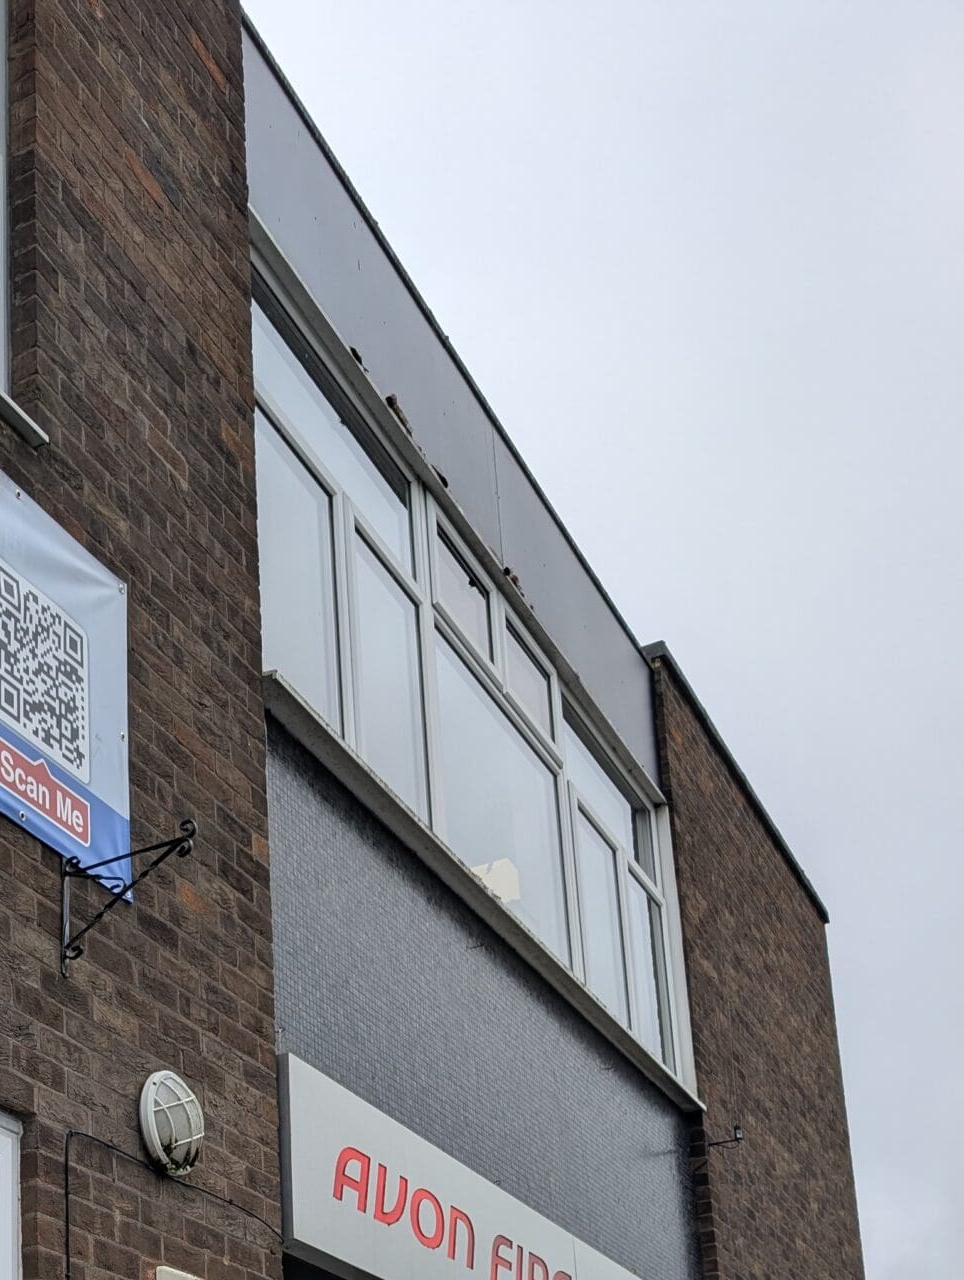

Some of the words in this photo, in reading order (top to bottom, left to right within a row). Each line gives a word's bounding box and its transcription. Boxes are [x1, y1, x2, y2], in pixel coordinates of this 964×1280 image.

[0, 750, 50, 810] Scan
[56, 790, 84, 833] Me
[332, 1146, 476, 1270] AVON
